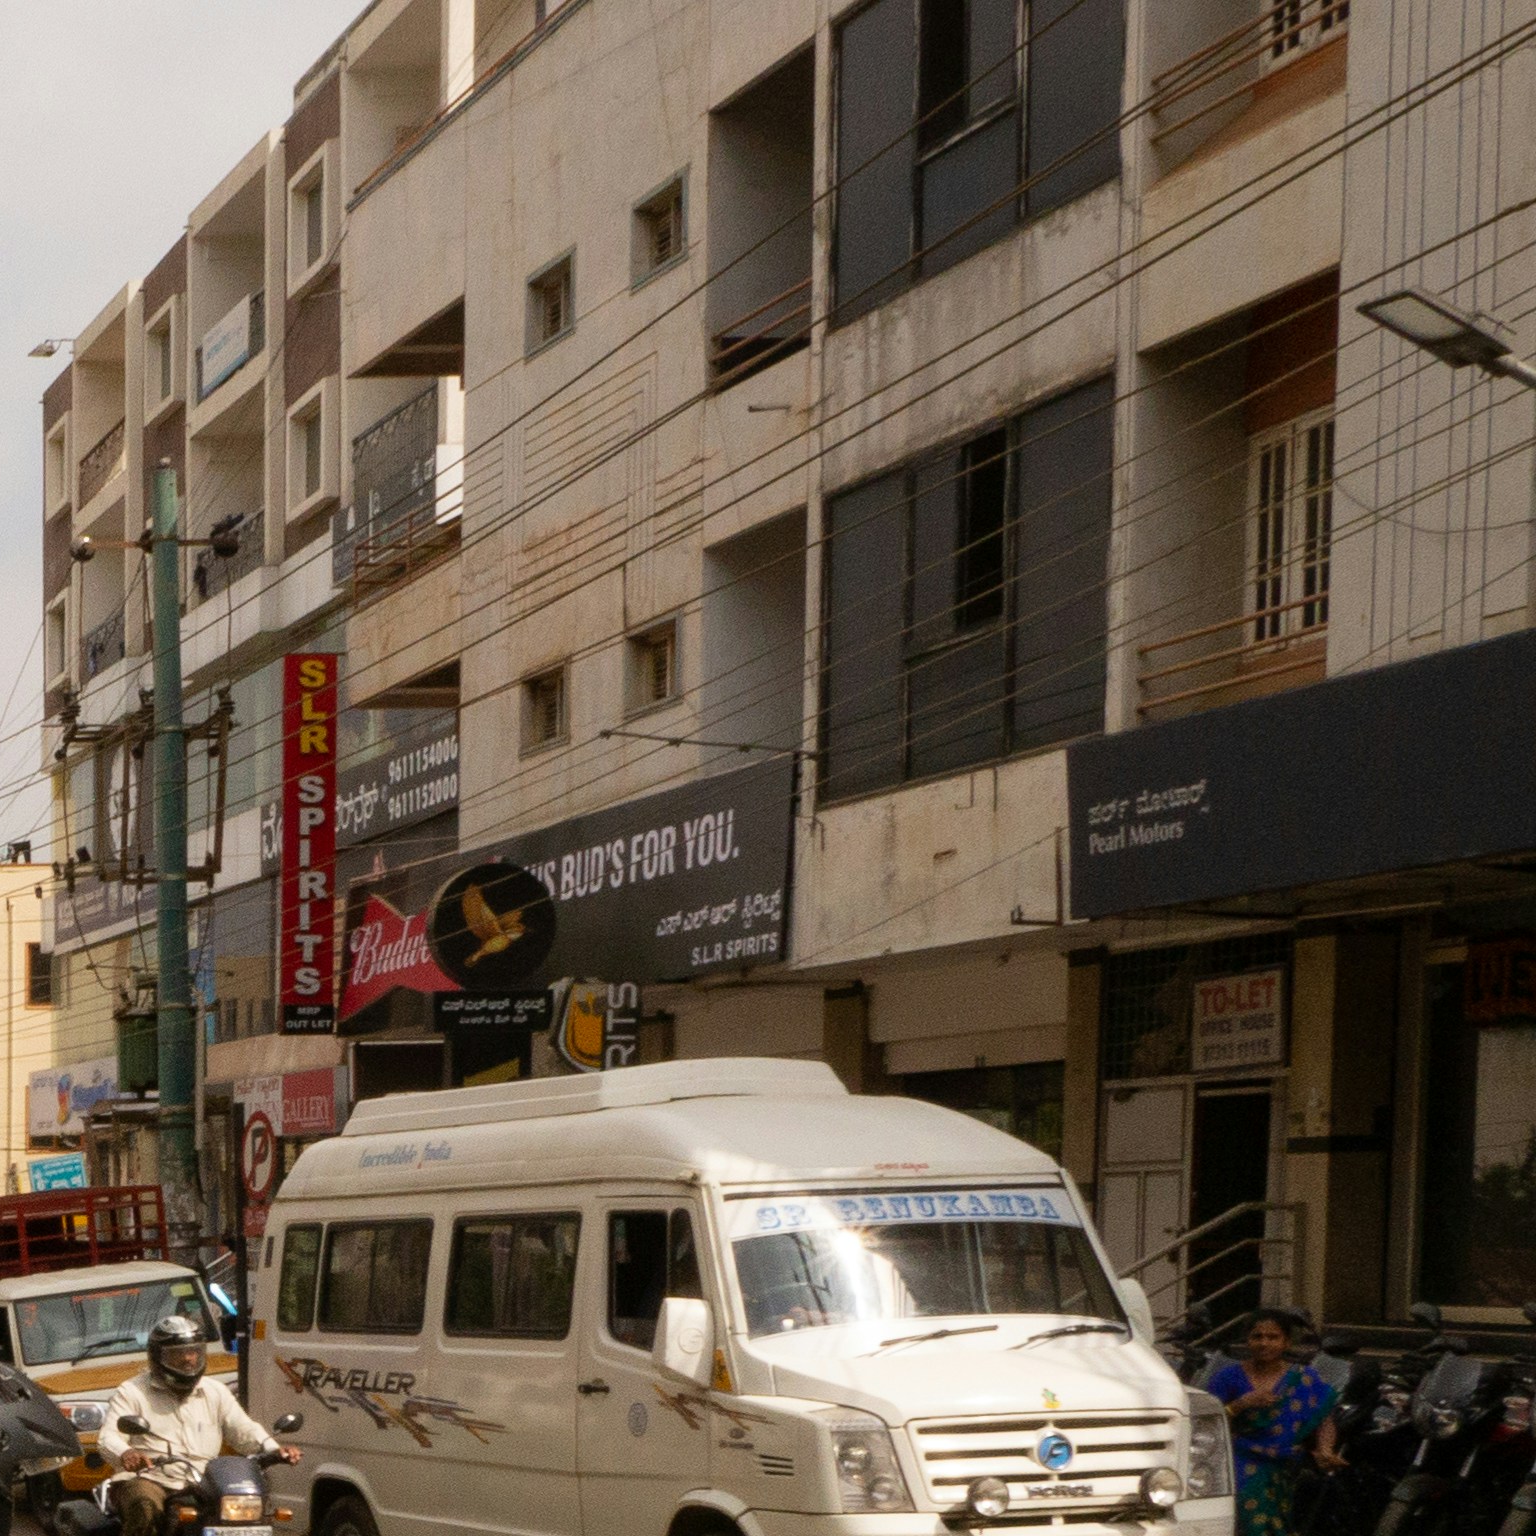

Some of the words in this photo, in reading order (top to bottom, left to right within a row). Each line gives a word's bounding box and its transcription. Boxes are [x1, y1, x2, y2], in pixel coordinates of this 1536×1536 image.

[298, 659, 329, 755] SLR
[560, 838, 625, 900] BUD'S
[630, 825, 677, 883] FOR
[684, 808, 740, 870] YOU.
[1089, 825, 1126, 855] Pearl
[1129, 820, 1185, 846] Motors
[294, 775, 327, 996] SPIRITS
[726, 932, 778, 960] SPIRITS
[1199, 976, 1276, 1018] TO-LET
[286, 1020, 309, 1030] OUT
[312, 1019, 332, 1029] LET
[836, 1194, 1061, 1222] RENUKAMBA
[301, 1361, 416, 1396] TRAVELLER
